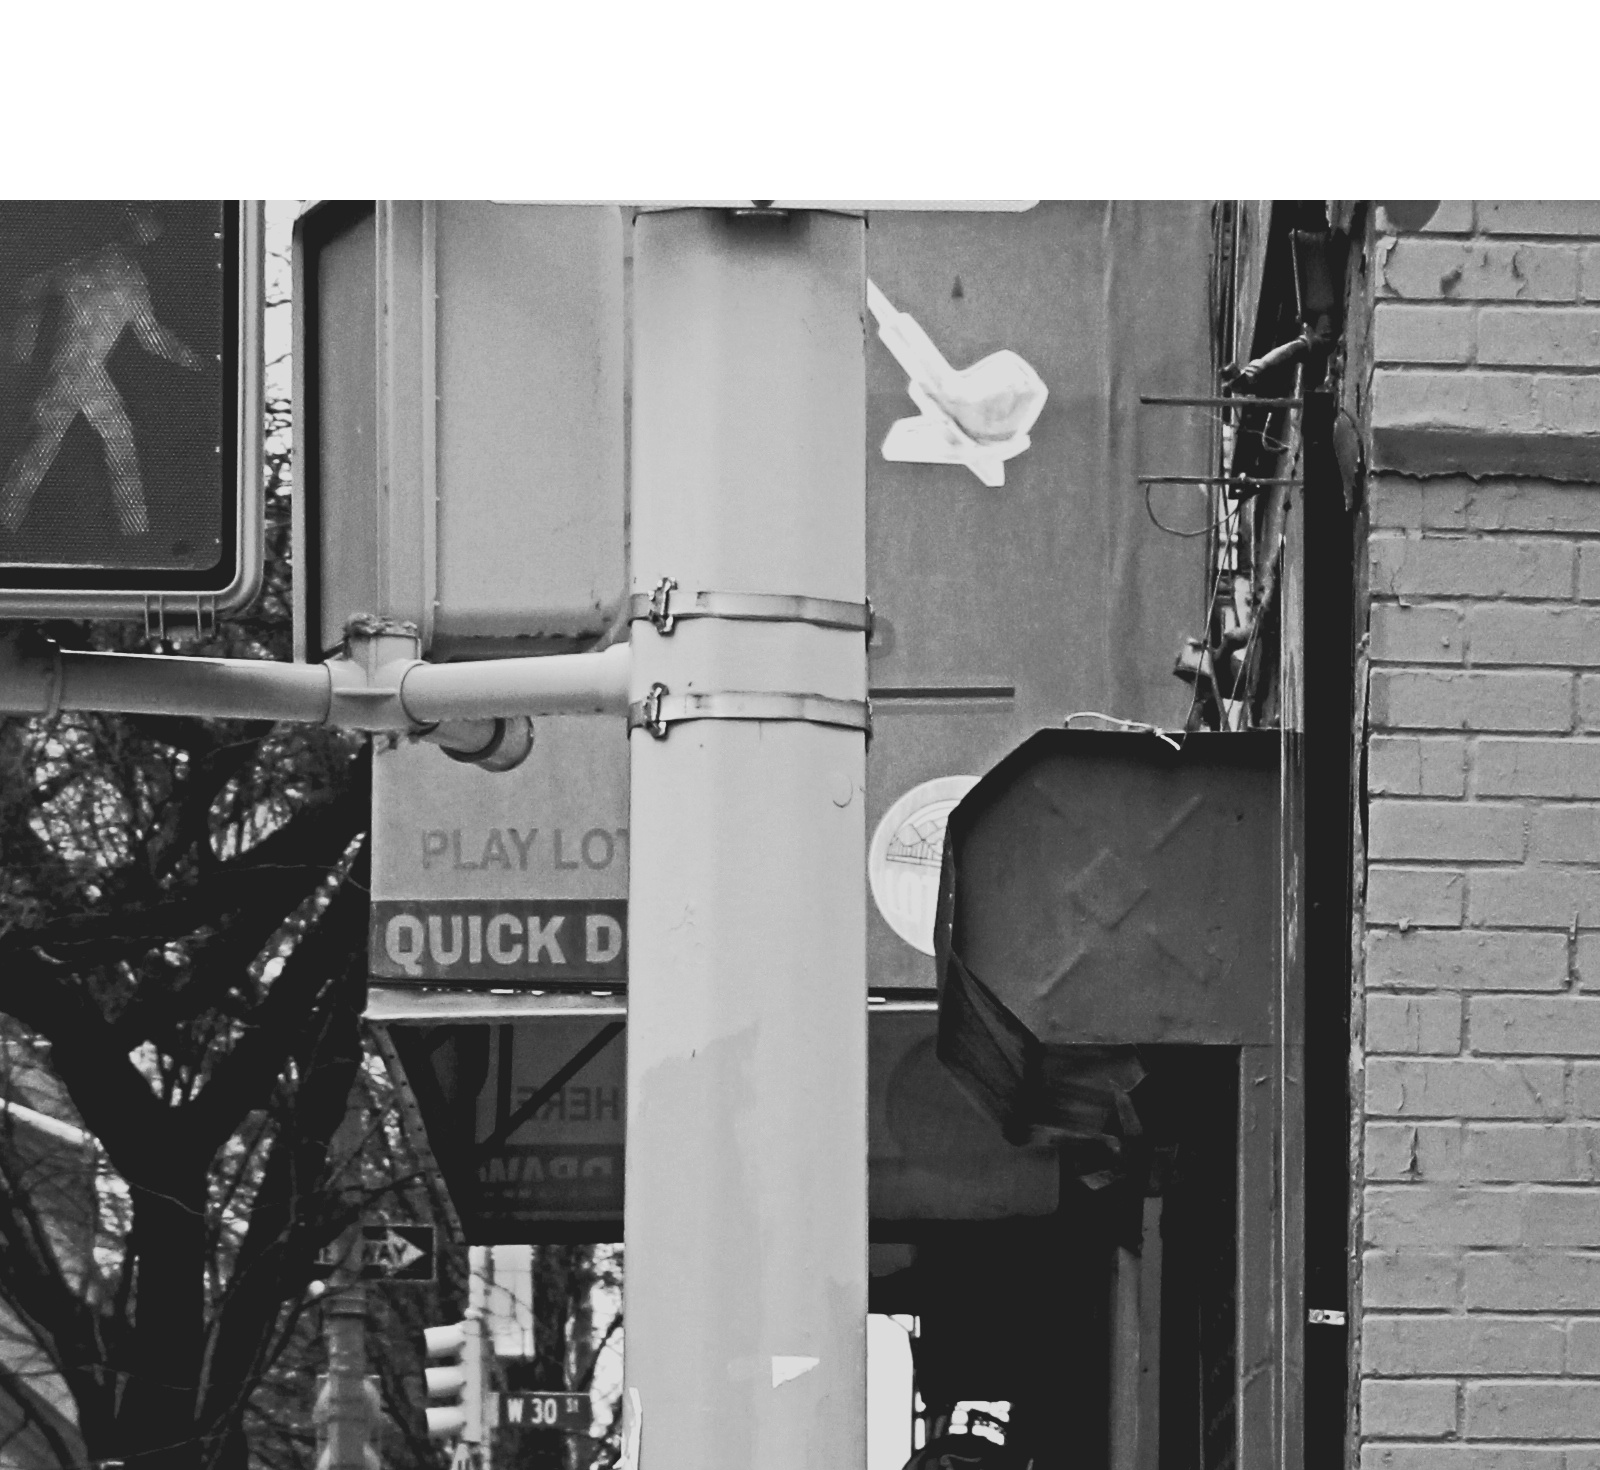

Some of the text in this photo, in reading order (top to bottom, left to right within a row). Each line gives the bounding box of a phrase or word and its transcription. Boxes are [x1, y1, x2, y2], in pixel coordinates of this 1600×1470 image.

[421, 827, 540, 871] PLAY
[385, 913, 567, 977] QUICK
[506, 1398, 525, 1423] W
[531, 1397, 557, 1424] 30
